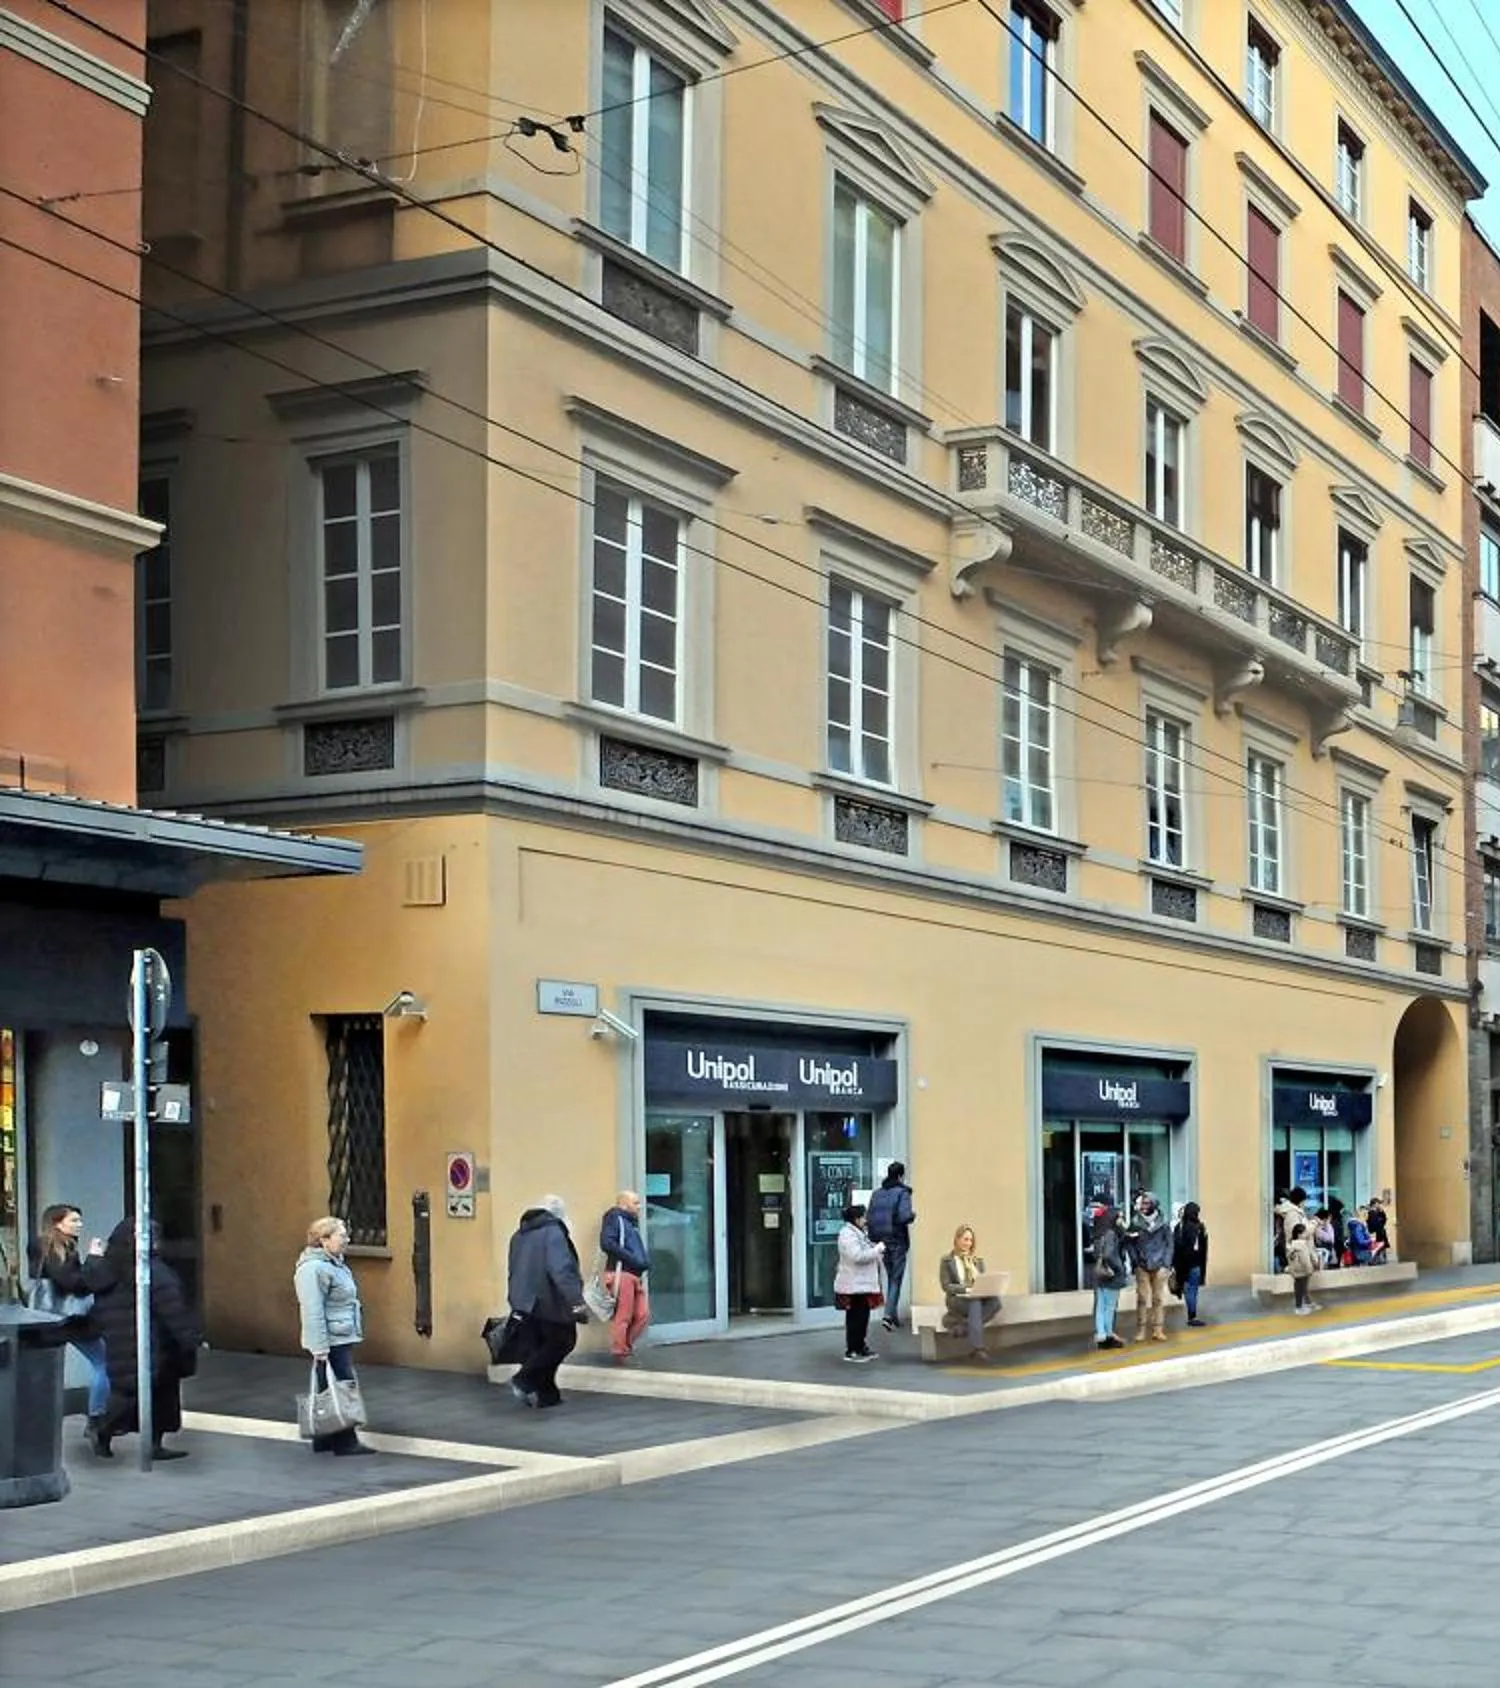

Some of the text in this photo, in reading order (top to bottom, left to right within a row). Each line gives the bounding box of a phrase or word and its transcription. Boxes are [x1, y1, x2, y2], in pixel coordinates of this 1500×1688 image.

[687, 1050, 755, 1086] Unipol
[800, 1058, 857, 1091] Unipol
[1099, 1079, 1136, 1105] Unipol
[1309, 1092, 1336, 1113] Unipol
